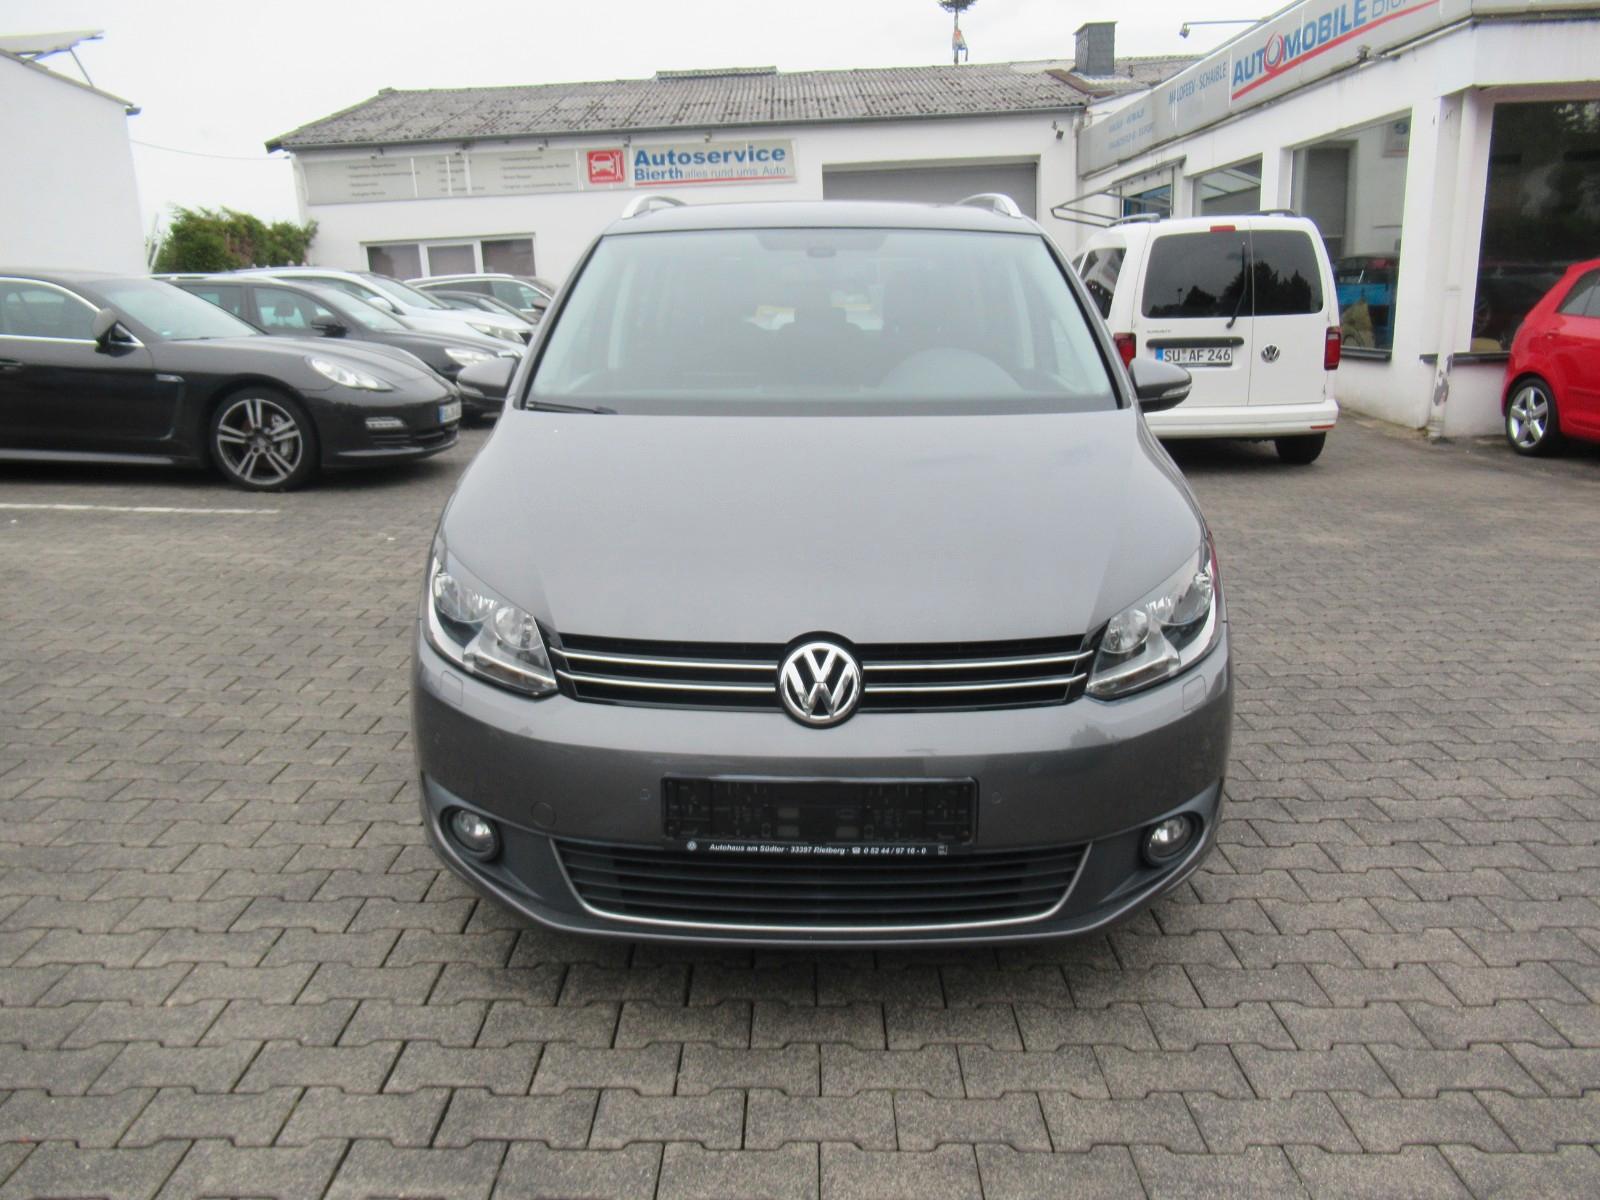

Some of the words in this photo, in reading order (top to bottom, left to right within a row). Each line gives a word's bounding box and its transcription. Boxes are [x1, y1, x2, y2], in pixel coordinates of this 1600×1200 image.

[1232, 0, 1368, 87] AUTOMOBILE
[634, 145, 786, 167] Autoservice
[634, 166, 684, 181] Bierth
[685, 167, 708, 178] alles
[711, 166, 733, 178] rund
[736, 167, 758, 177] ums
[762, 165, 786, 176] Auto
[1164, 349, 1181, 362] SU
[1188, 349, 1204, 362] AF
[1207, 348, 1231, 361] 246
[708, 843, 745, 852] Autohaus
[746, 844, 758, 852] am
[760, 844, 784, 853] Südtor
